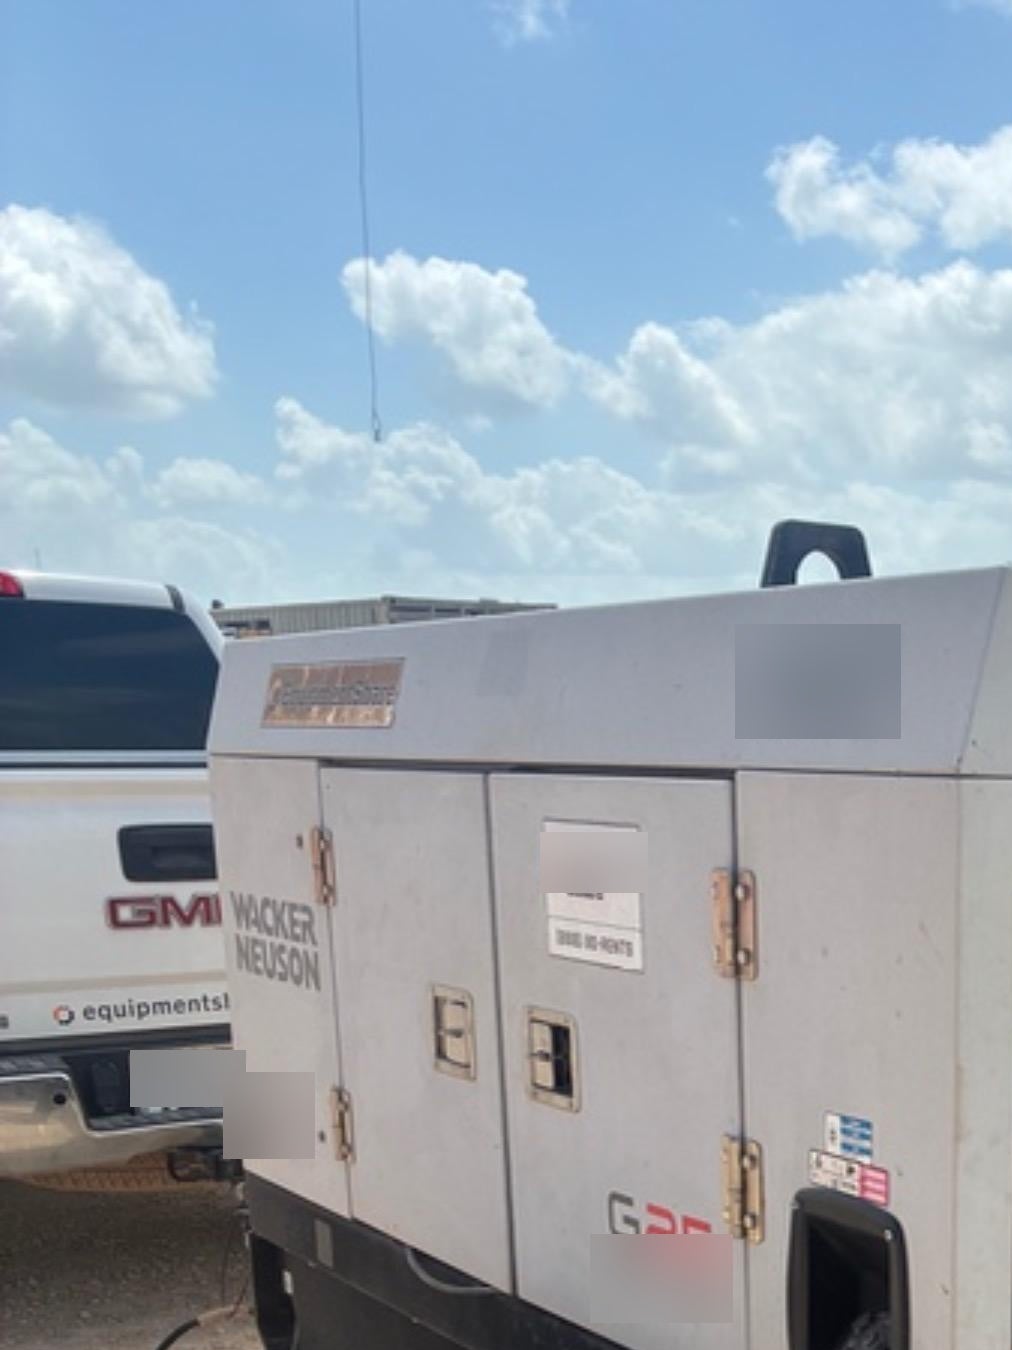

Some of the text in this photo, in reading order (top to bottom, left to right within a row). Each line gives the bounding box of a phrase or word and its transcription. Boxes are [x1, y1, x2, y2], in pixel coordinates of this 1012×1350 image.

[106, 895, 222, 929] GM
[229, 890, 318, 947] WACKER
[235, 932, 321, 992] NEUSON
